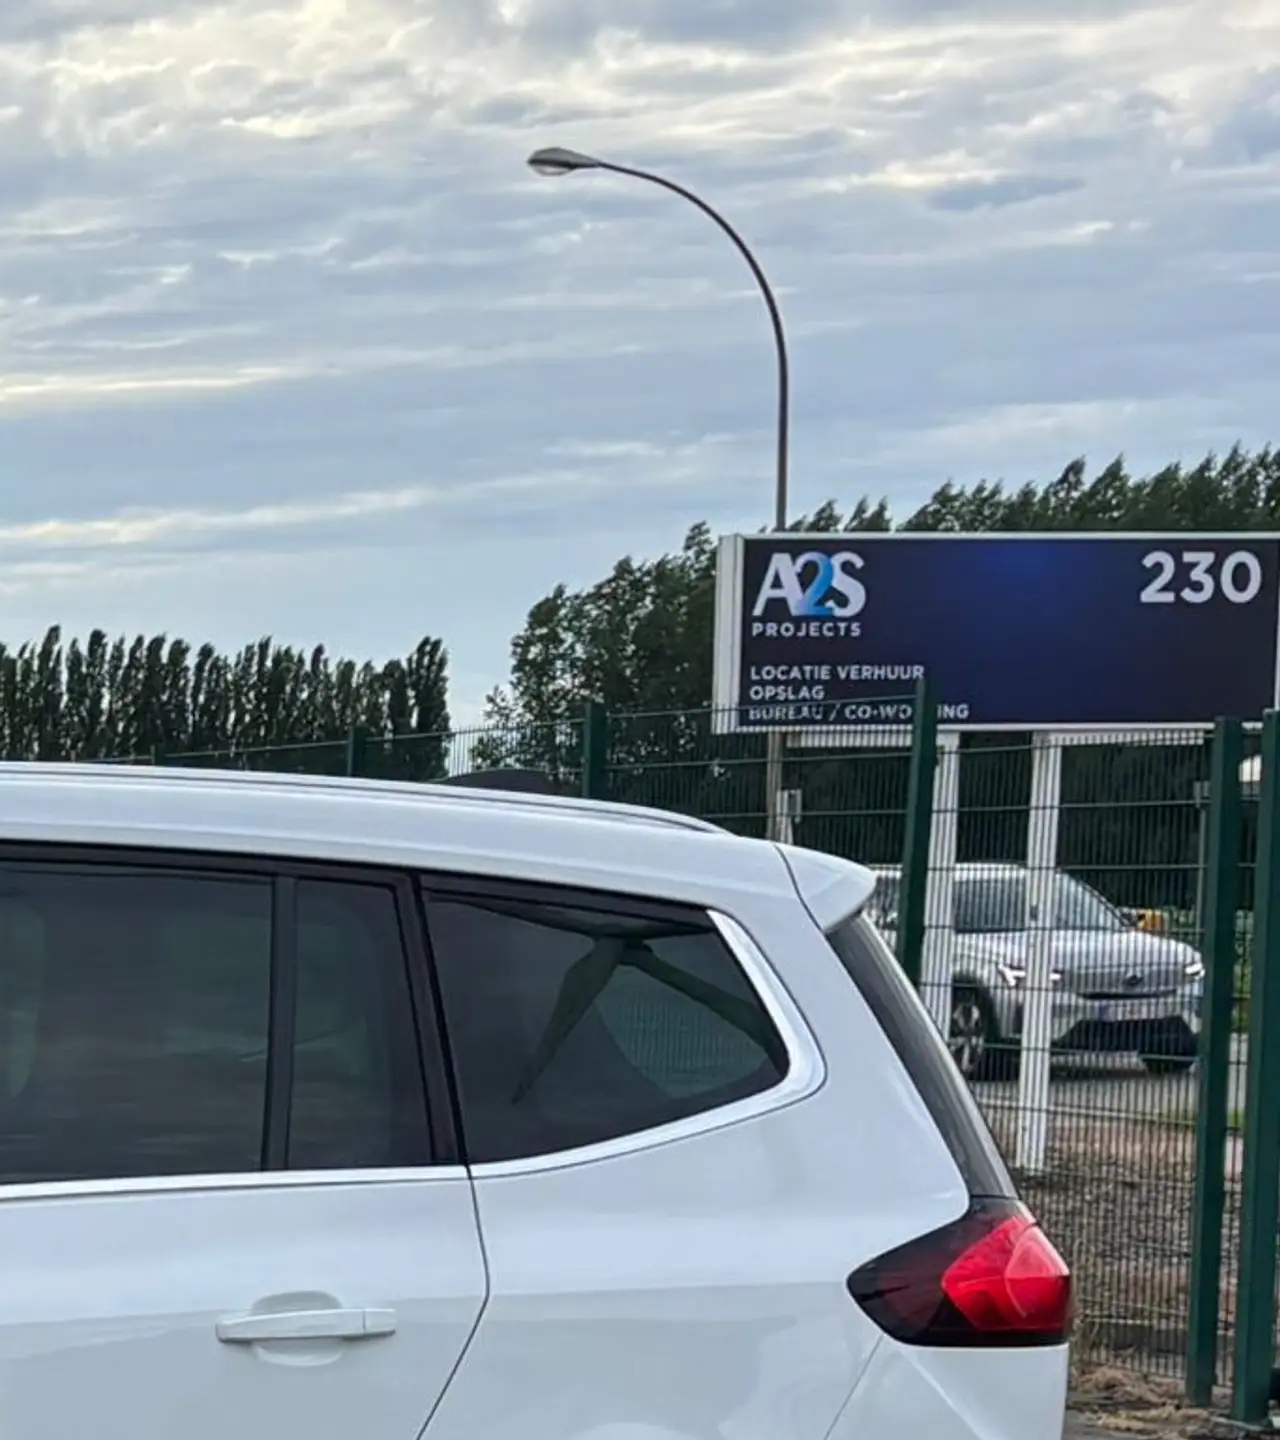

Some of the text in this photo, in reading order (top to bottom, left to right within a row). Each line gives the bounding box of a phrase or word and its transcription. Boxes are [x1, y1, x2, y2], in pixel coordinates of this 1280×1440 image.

[752, 551, 866, 617] A2S
[1140, 550, 1262, 603] 230
[752, 622, 862, 637] PROJECTS
[750, 666, 925, 680] LOCATIE VERHUUR
[749, 686, 825, 700] OPSLAG
